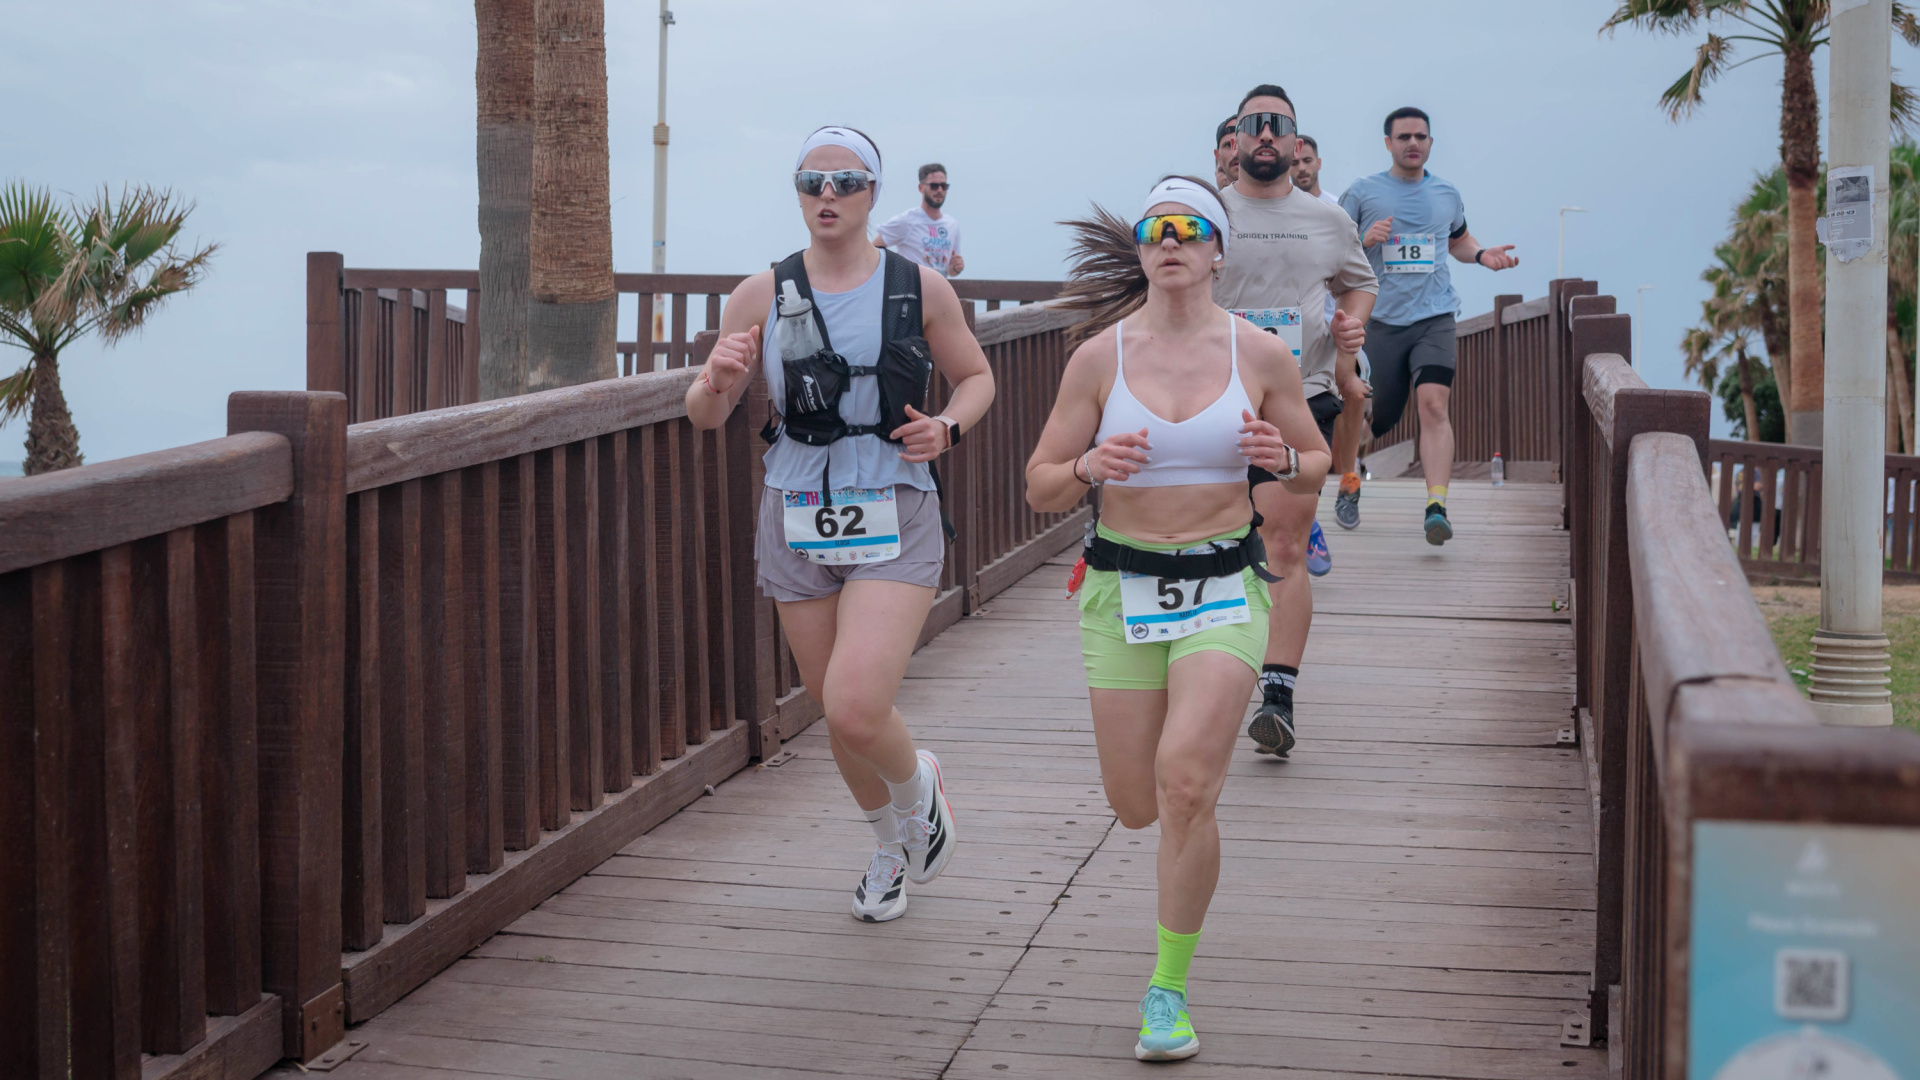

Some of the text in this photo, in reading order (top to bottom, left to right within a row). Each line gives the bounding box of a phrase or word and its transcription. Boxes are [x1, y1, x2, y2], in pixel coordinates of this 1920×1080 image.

[1269, 233, 1309, 241] TRAINING
[1397, 245, 1421, 259] 18
[815, 505, 867, 538] 62
[1157, 577, 1208, 611] 57
